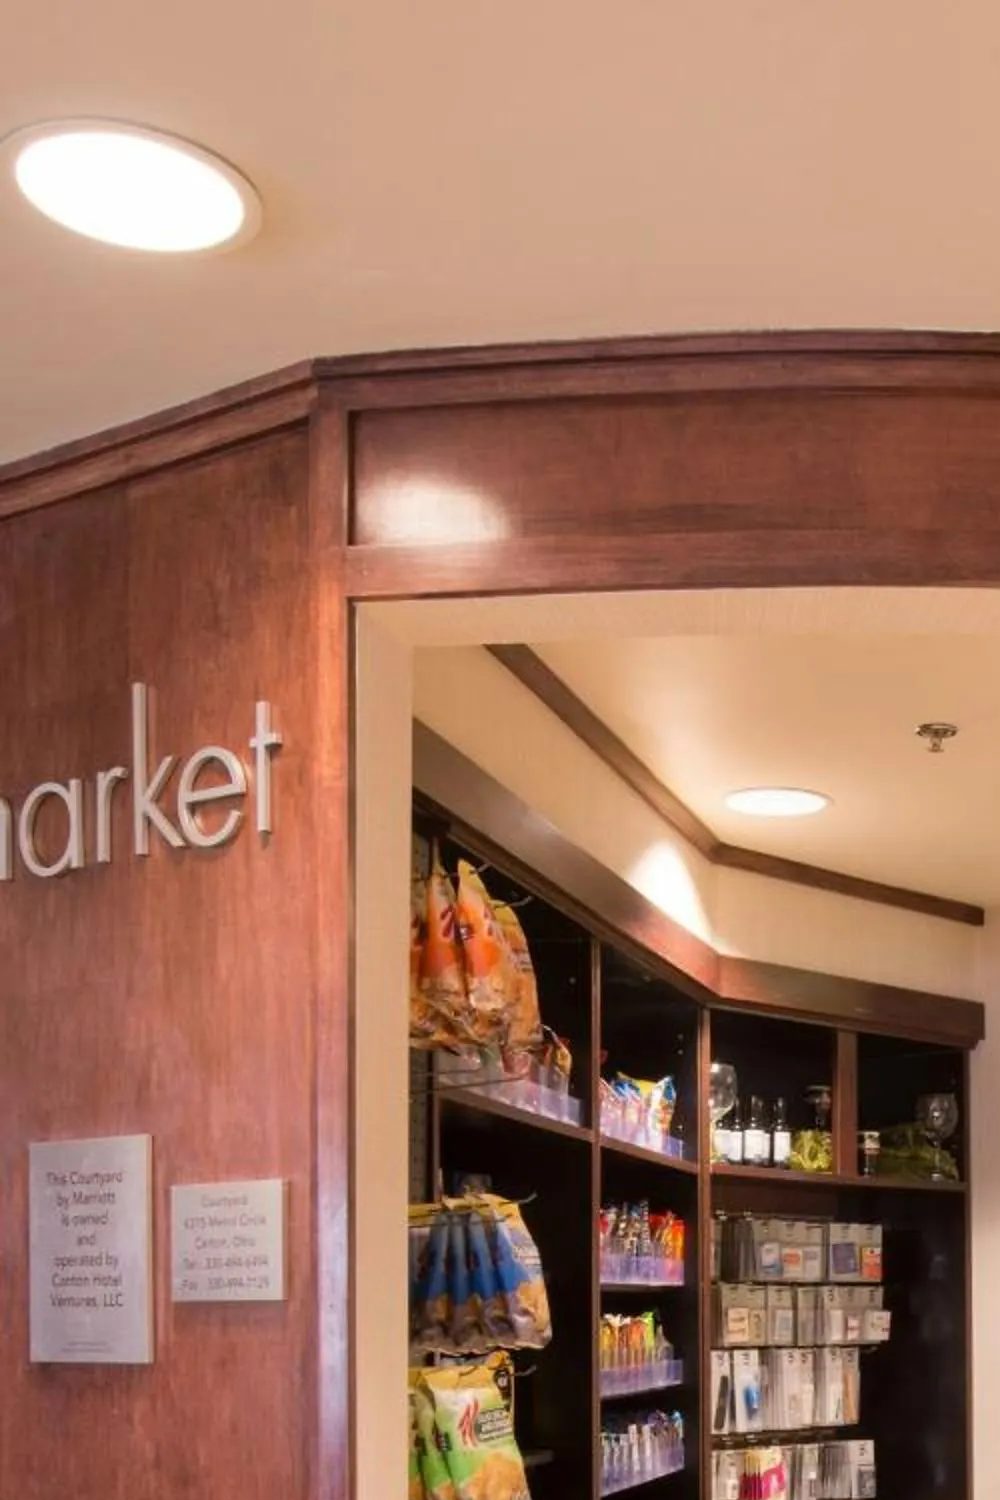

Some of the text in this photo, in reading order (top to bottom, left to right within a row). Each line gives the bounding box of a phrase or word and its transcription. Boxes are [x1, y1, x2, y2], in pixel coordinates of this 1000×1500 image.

[0, 682, 282, 880] arket
[47, 1171, 123, 1188] This Courtyard
[56, 1191, 116, 1209] by Marriott
[71, 1211, 109, 1226] owned
[76, 1233, 97, 1247] and
[53, 1252, 119, 1271] operated by
[51, 1272, 91, 1288] Canton
[103, 1293, 124, 1308] LLC
